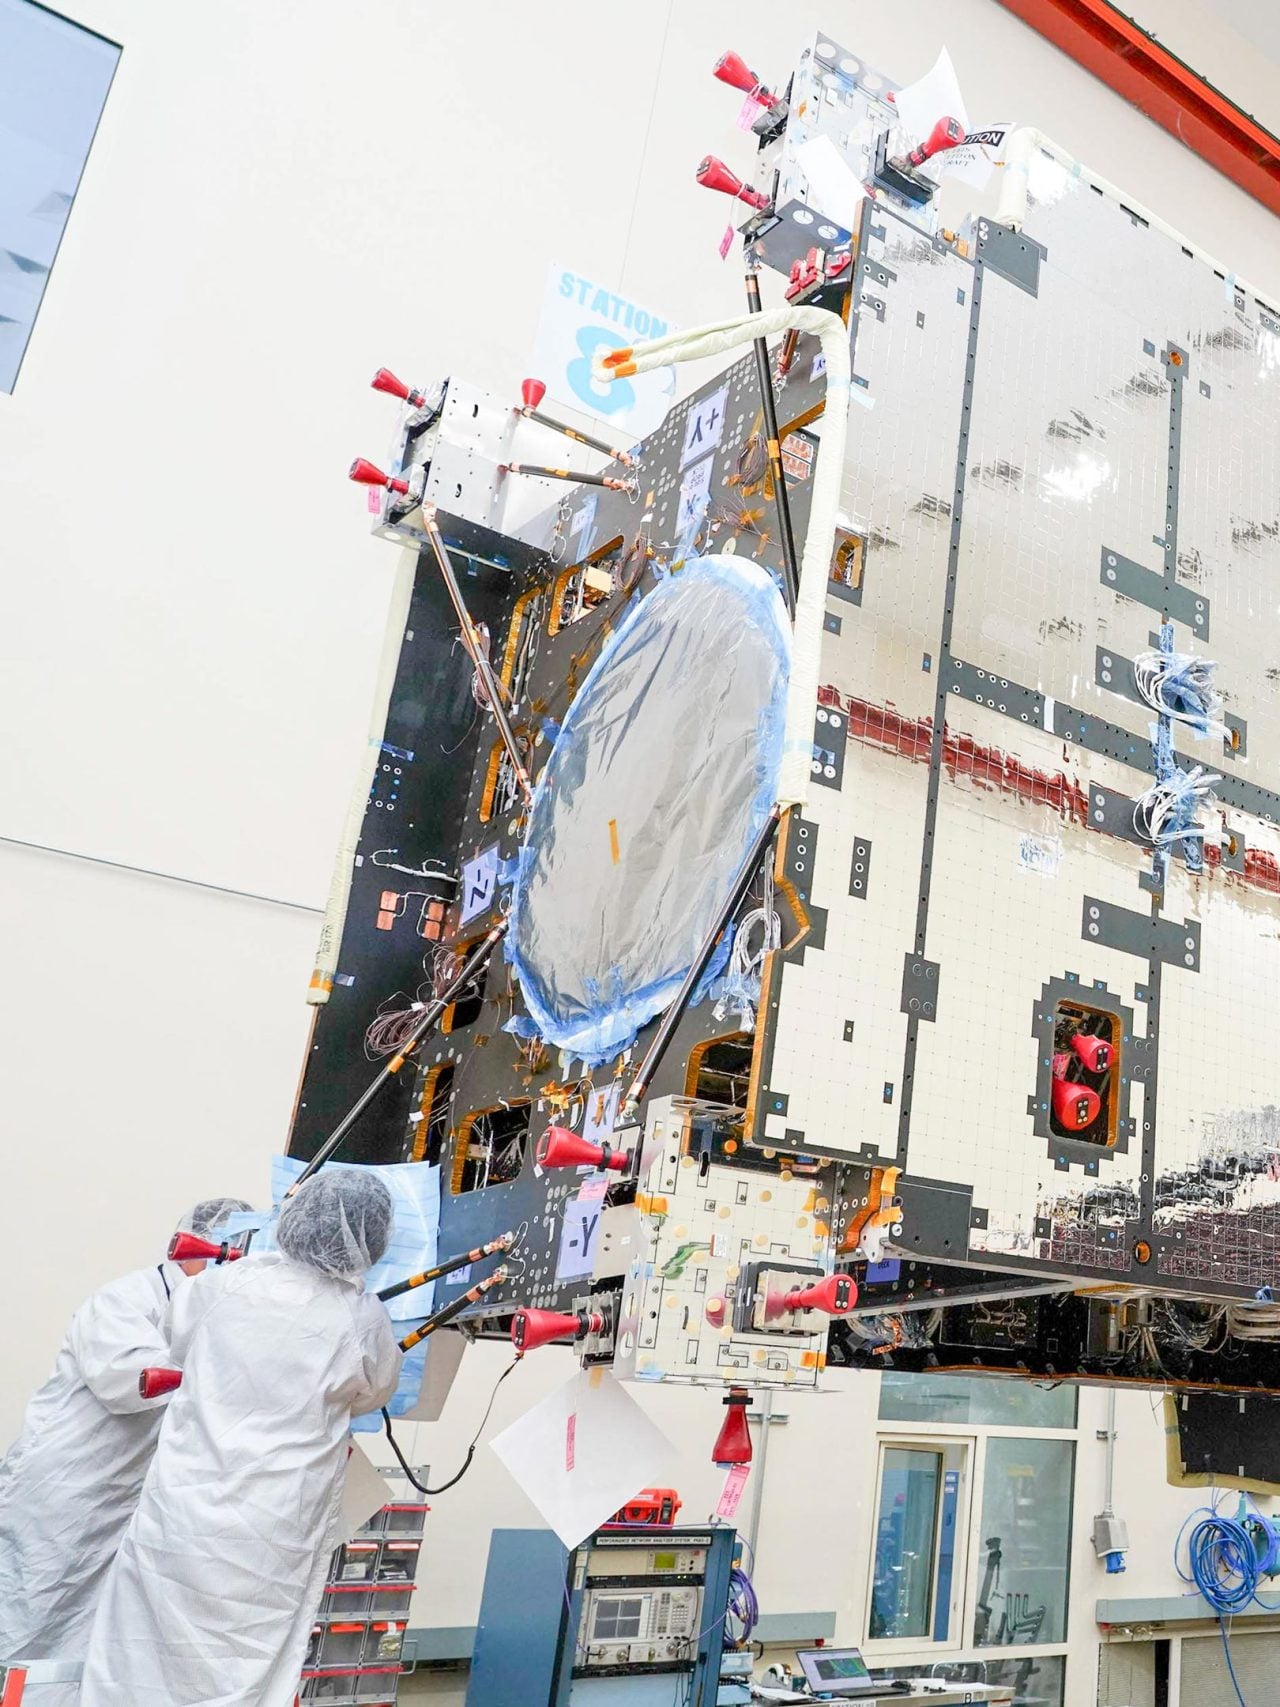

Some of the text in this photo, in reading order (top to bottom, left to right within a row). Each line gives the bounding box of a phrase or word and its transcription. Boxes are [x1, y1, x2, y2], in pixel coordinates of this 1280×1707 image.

[559, 272, 668, 341] STATION
[566, 326, 636, 415] 8
[569, 1214, 598, 1257] -Y
